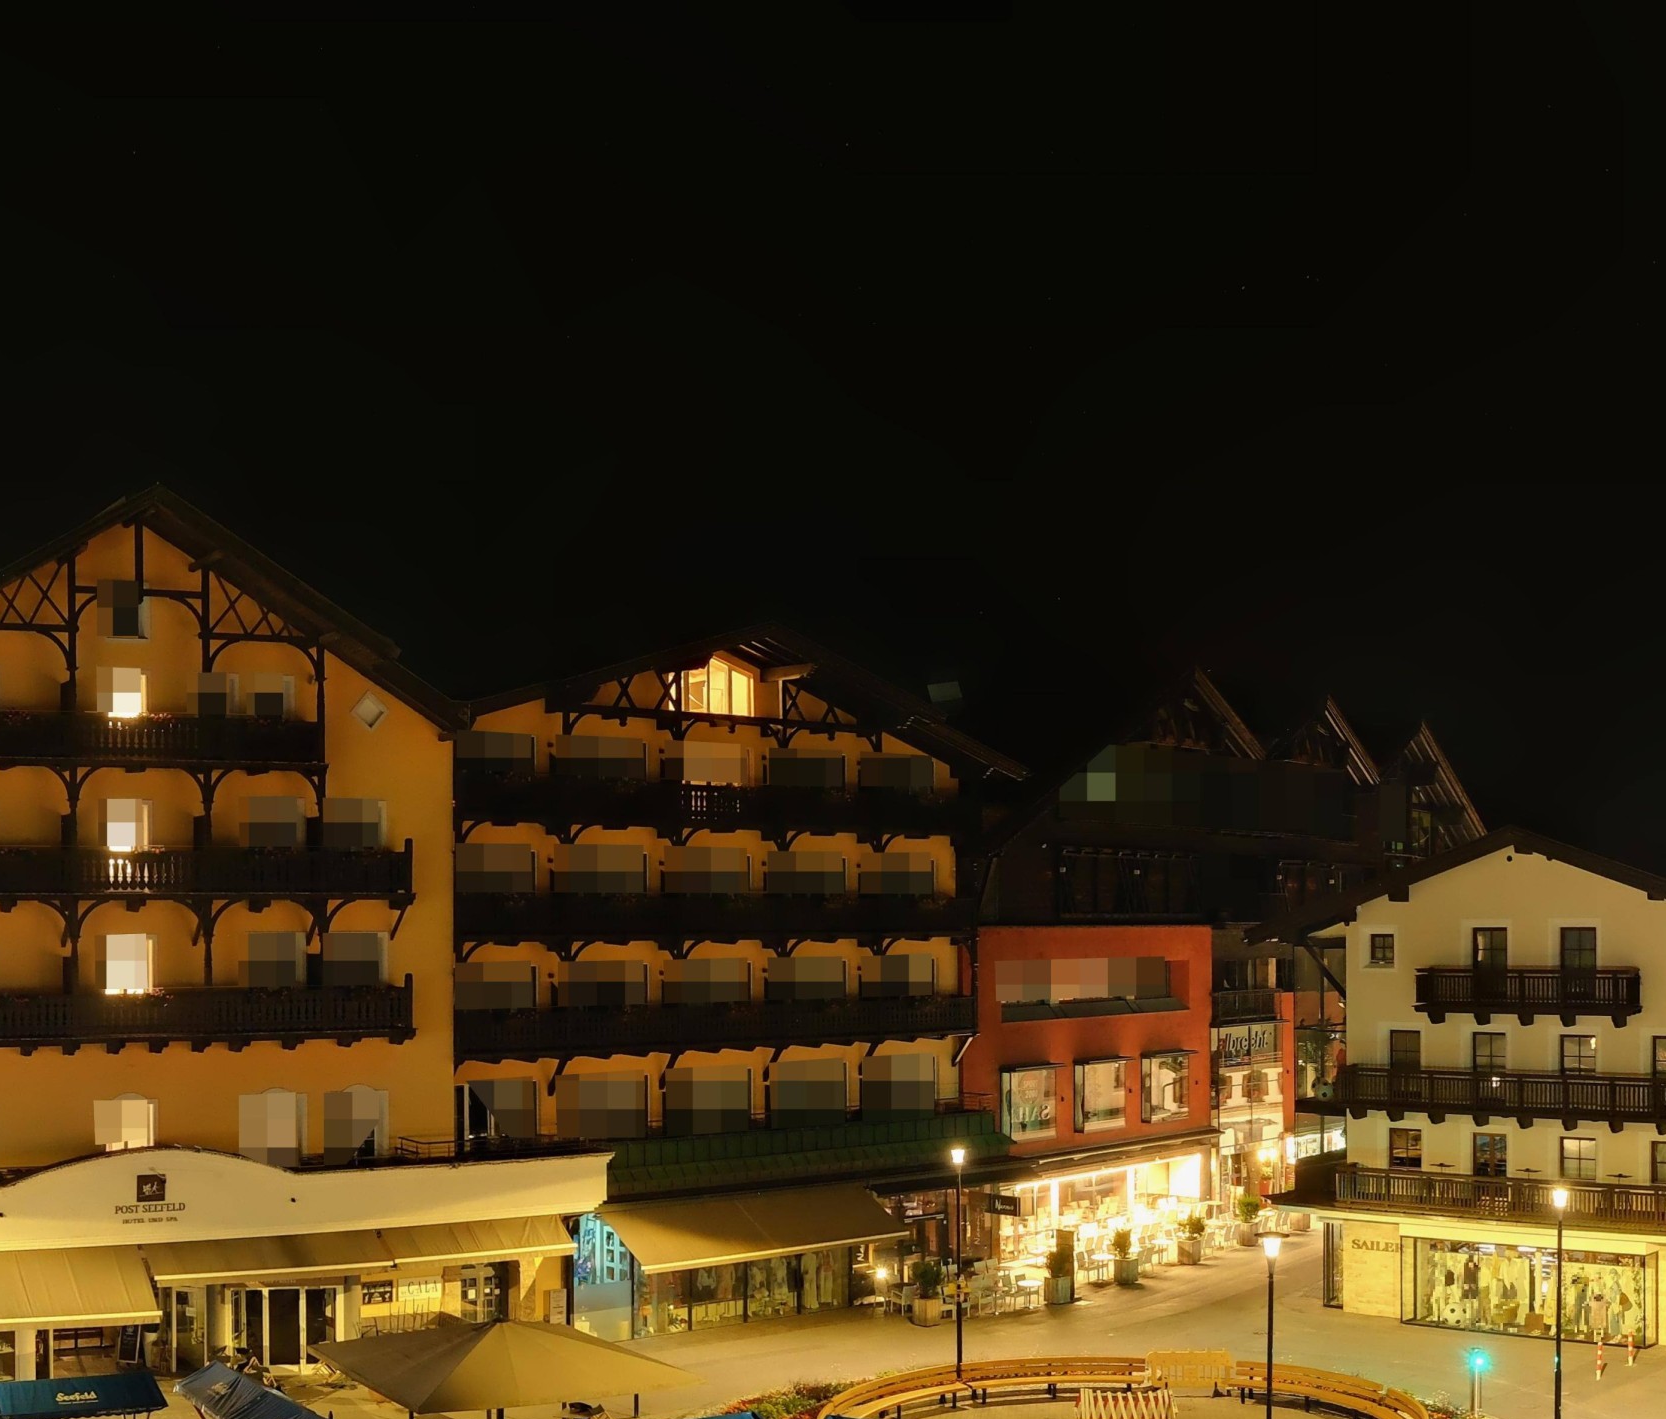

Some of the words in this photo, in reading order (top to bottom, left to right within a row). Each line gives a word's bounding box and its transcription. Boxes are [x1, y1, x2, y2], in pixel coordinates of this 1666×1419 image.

[115, 1205, 139, 1215] POST
[142, 1203, 186, 1214] SEEFELD
[56, 1391, 97, 1402] Seefeld
